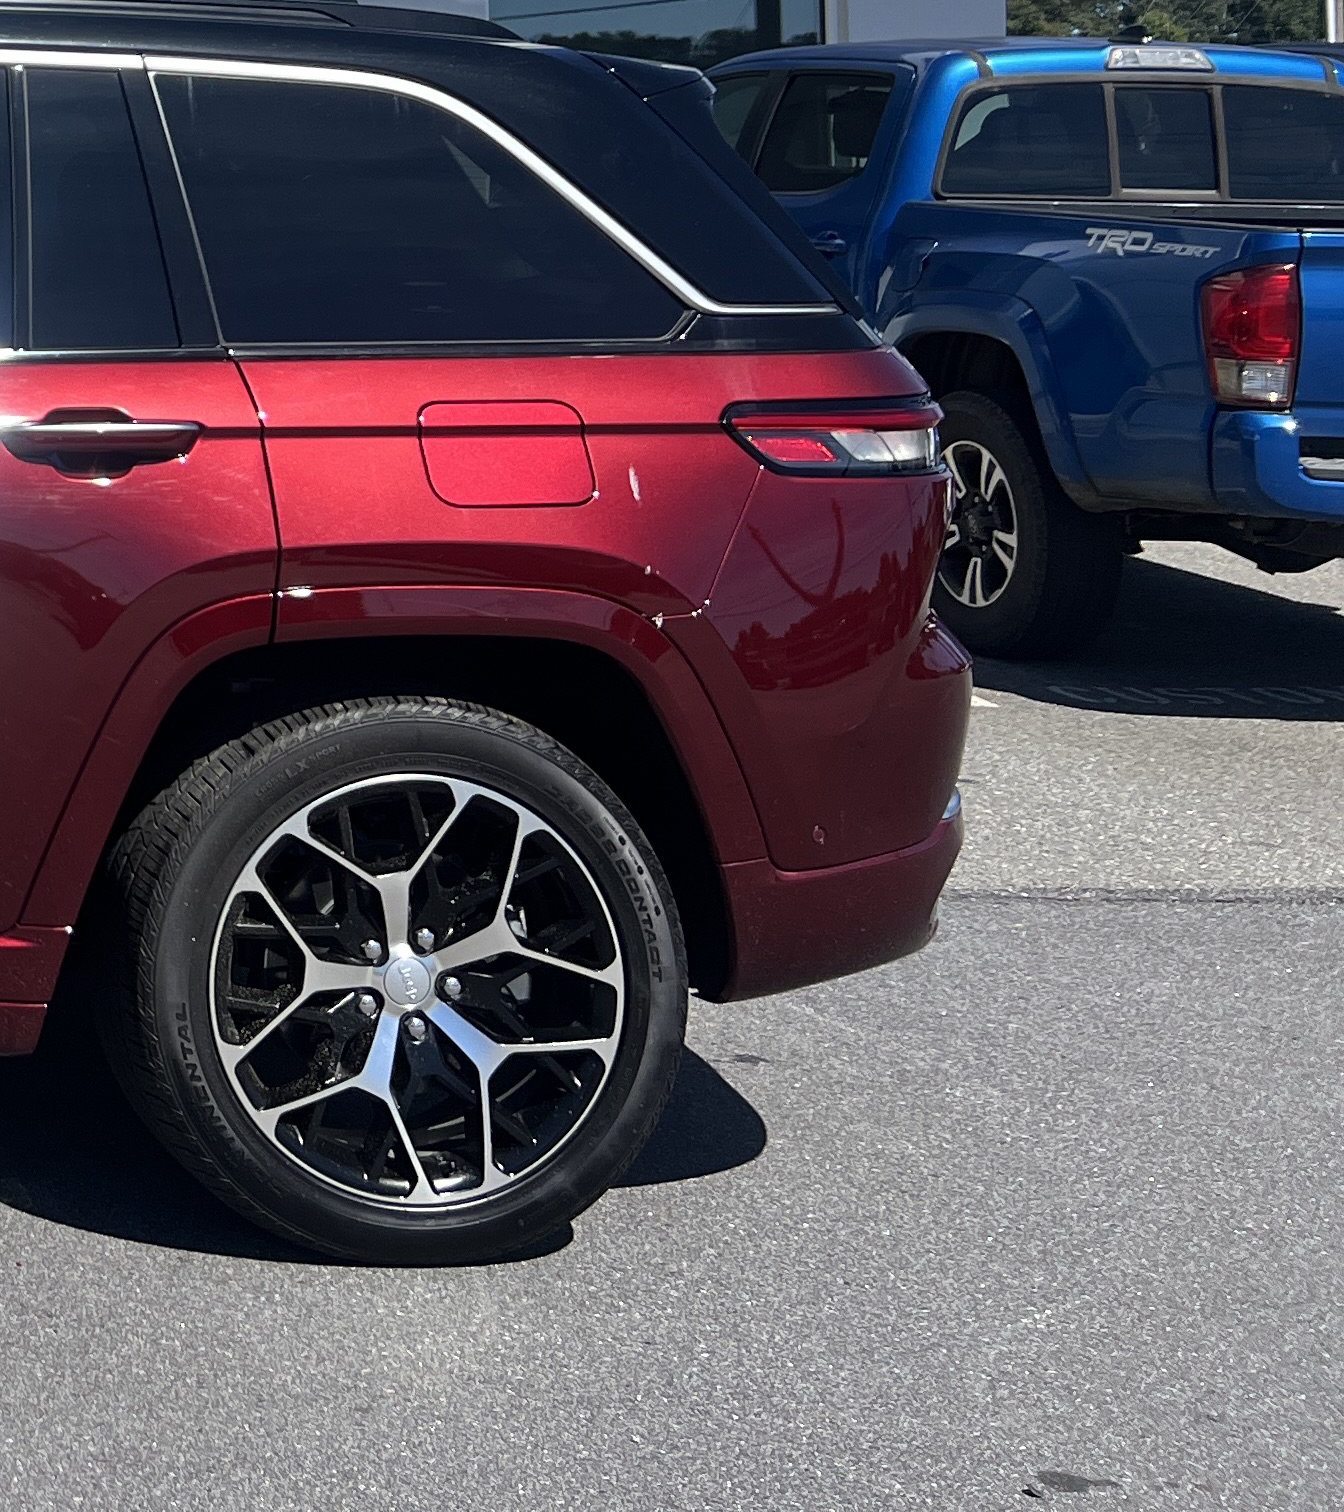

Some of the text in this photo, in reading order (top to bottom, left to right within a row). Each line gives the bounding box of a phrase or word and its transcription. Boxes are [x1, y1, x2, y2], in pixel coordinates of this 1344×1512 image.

[1084, 227, 1222, 259] TRD SPORT
[615, 858, 663, 984] CONTACT
